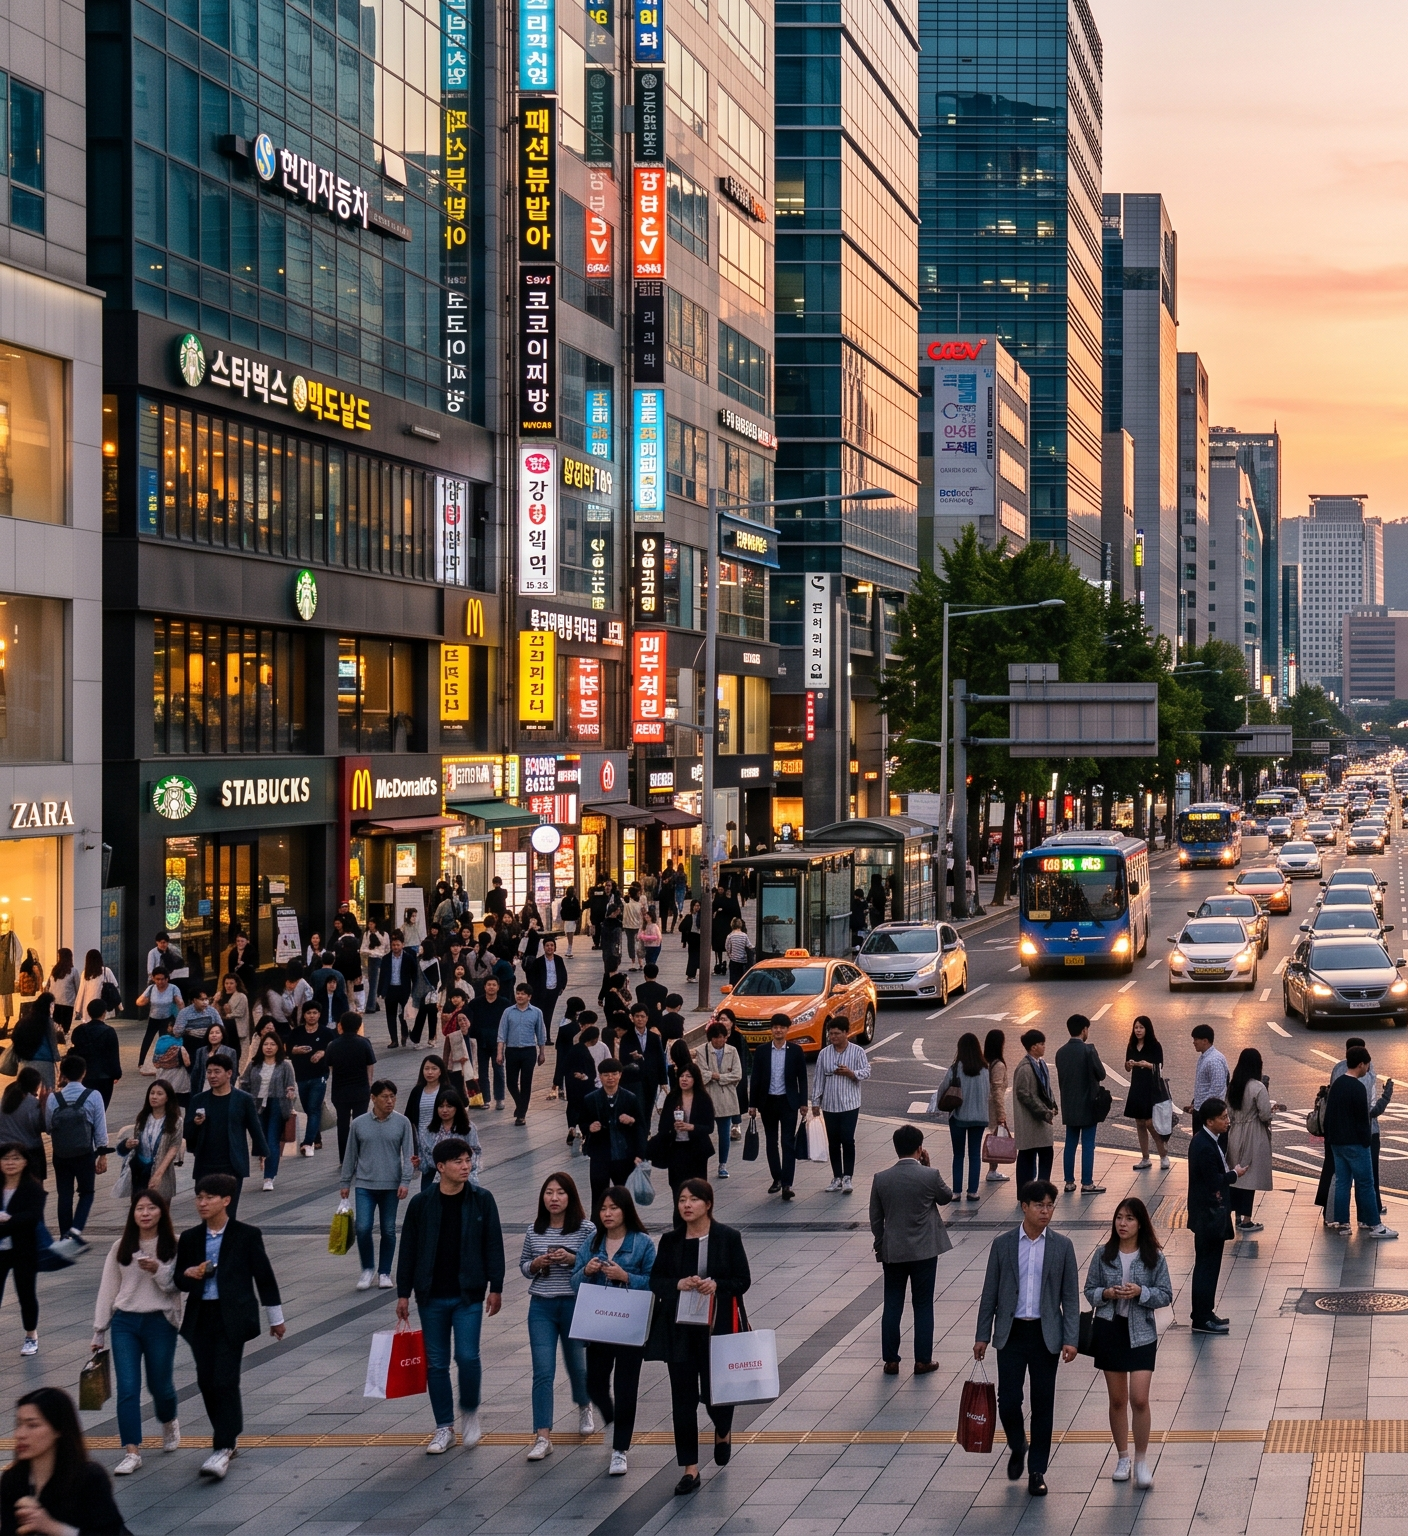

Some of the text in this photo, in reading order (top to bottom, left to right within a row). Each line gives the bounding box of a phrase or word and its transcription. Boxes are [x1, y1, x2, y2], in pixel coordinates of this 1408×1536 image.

[280, 148, 368, 229] 현대자동차
[526, 292, 549, 413] 코코이찌방
[211, 350, 288, 406] 스타벅스
[221, 776, 310, 808] STABUCKS
[375, 777, 437, 799] McDonald's
[10, 800, 75, 829] ZARA
